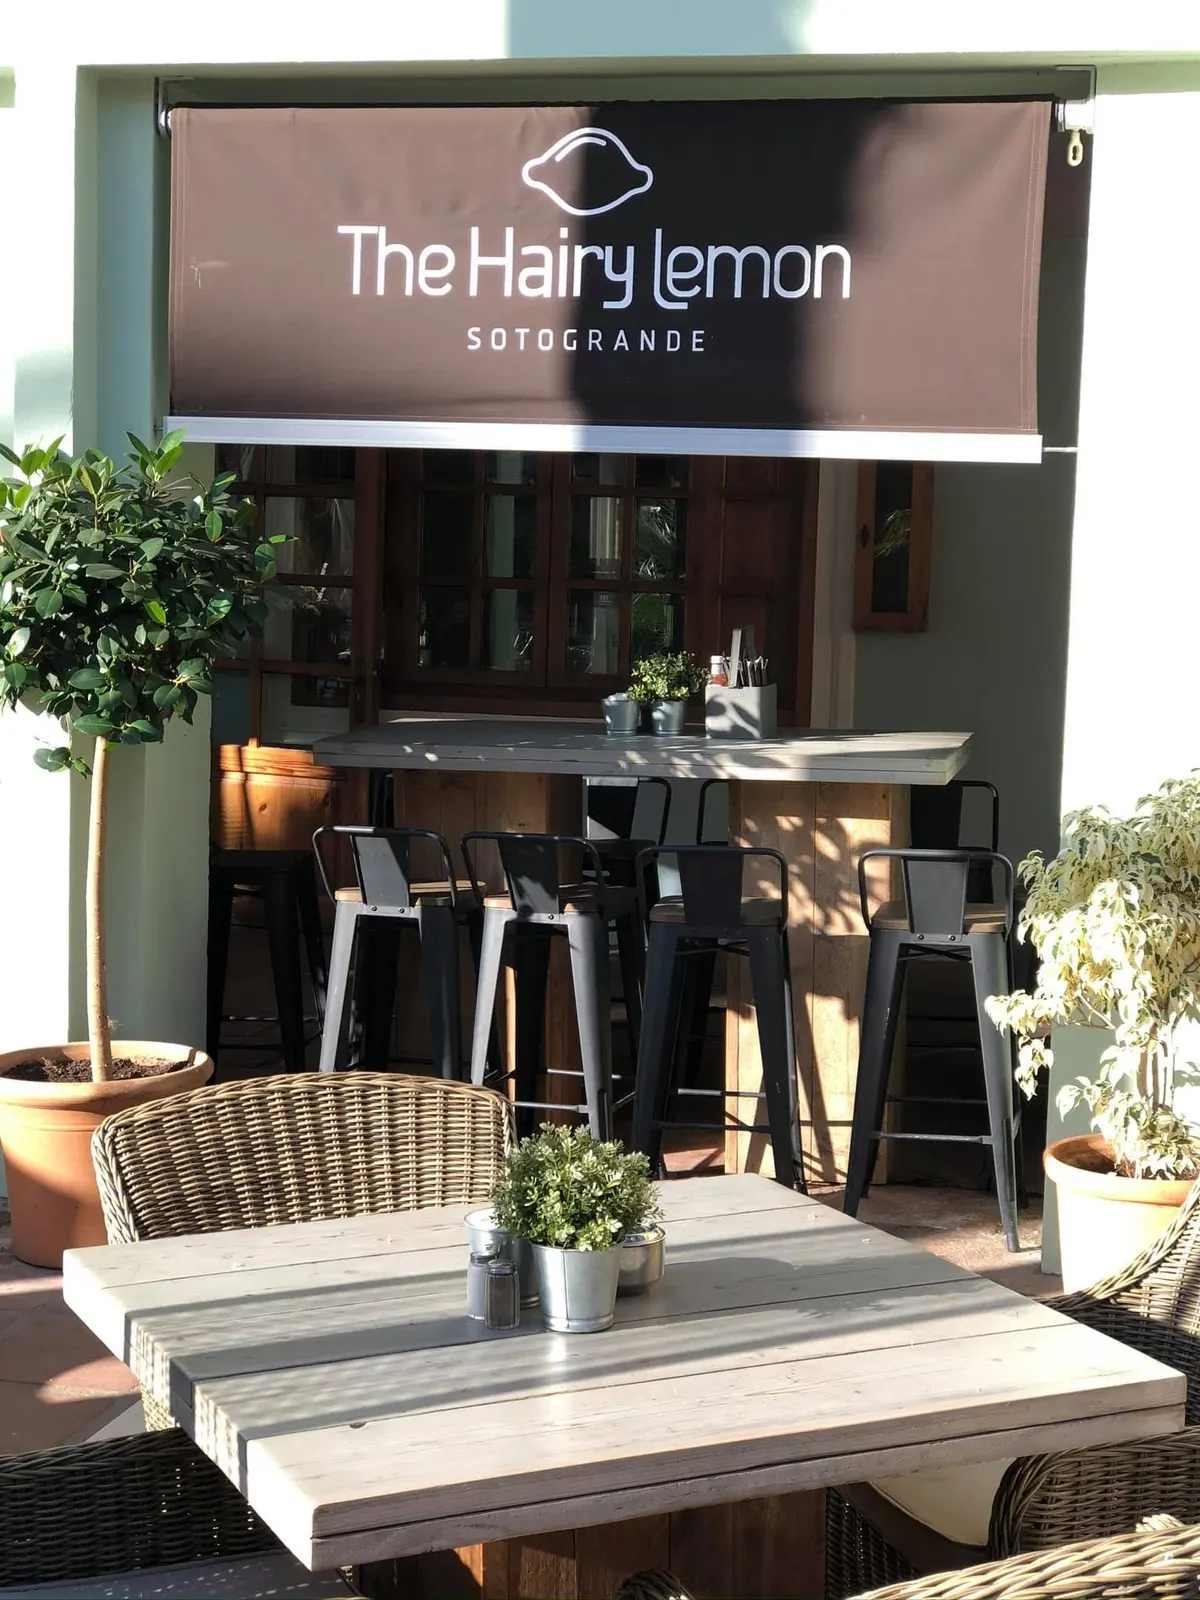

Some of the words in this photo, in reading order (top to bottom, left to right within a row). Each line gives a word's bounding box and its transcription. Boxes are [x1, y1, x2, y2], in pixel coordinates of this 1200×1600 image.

[337, 225, 456, 297] The
[469, 226, 635, 309] Hairy
[467, 327, 705, 352] SOTOGRANDE
